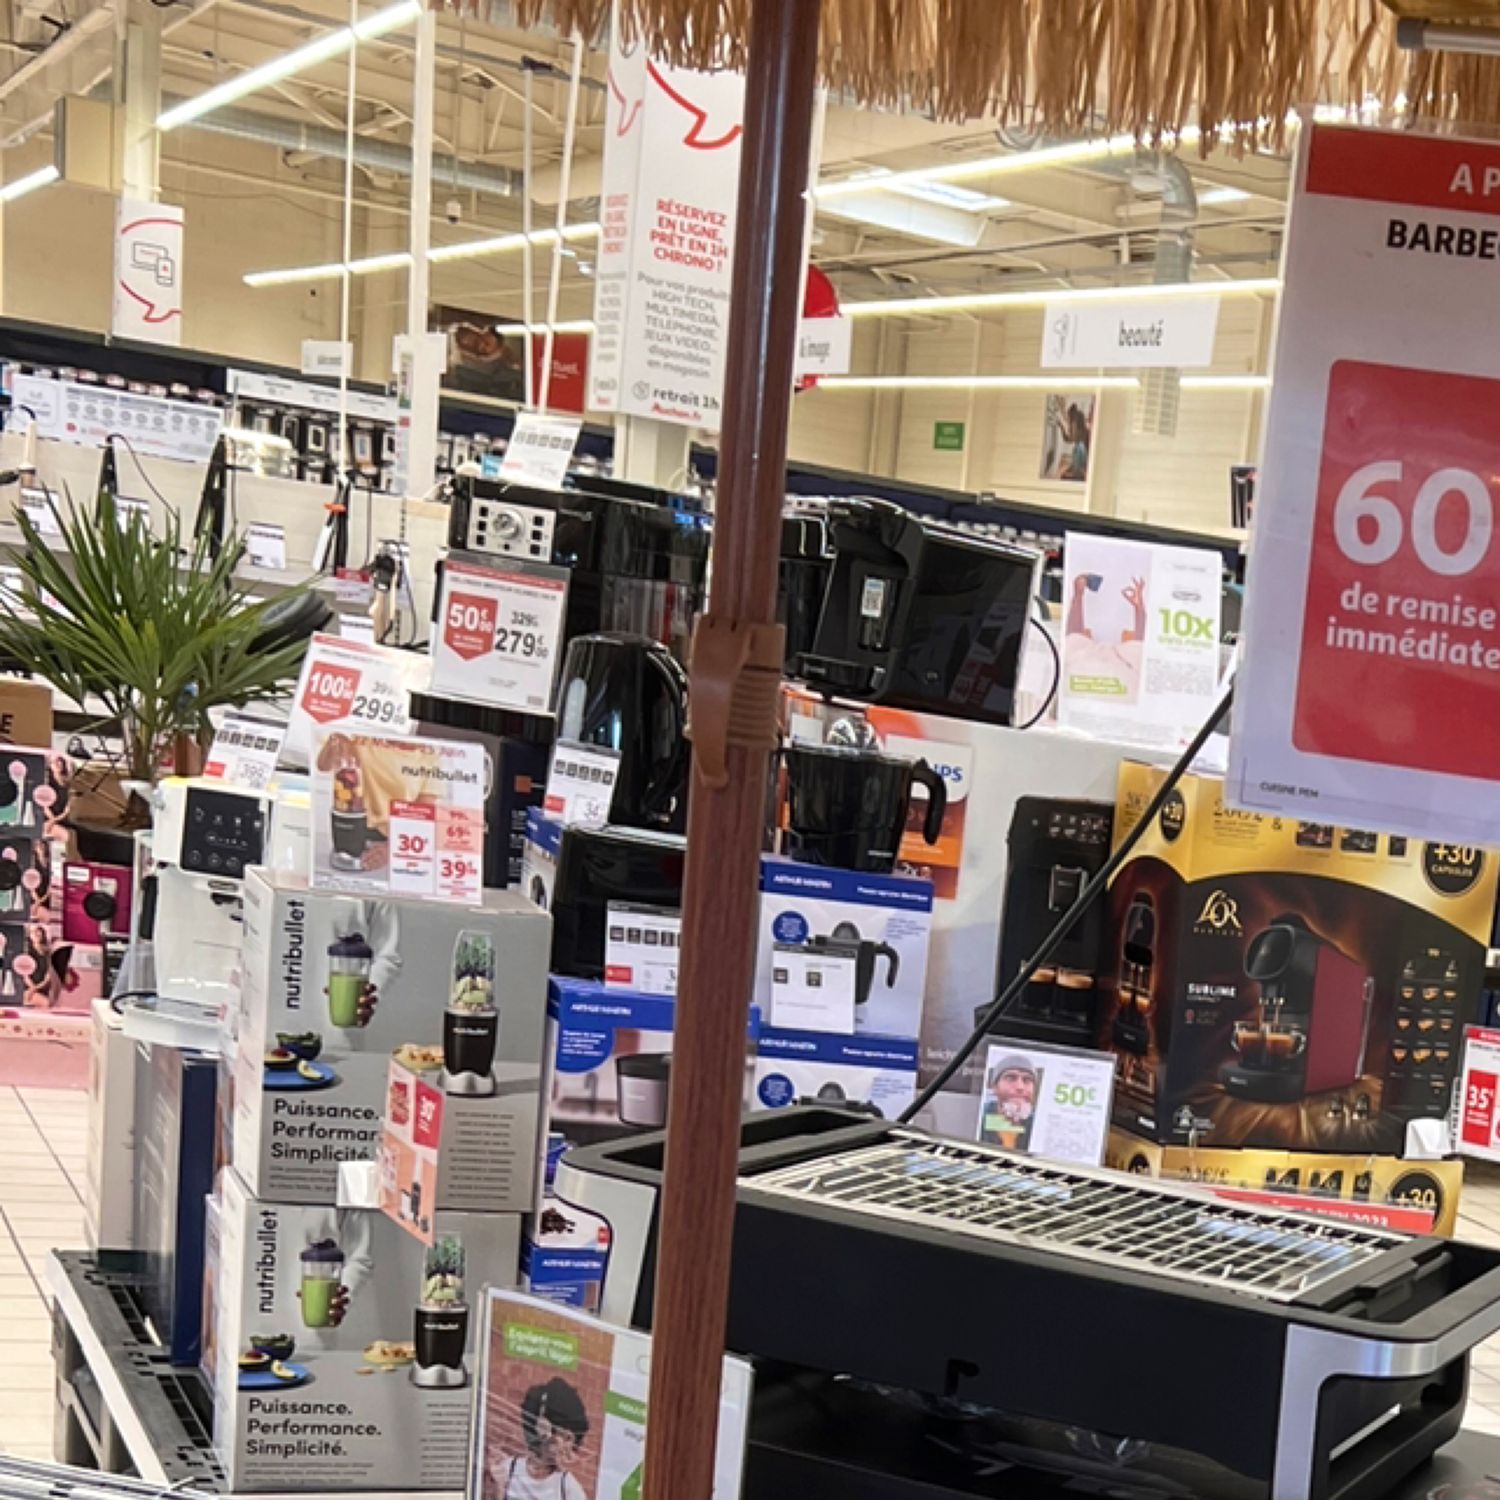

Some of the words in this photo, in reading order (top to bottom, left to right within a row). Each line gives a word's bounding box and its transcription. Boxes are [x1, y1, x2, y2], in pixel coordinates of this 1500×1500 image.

[1449, 162, 1475, 194] A
[658, 216, 675, 230] EN
[689, 238, 706, 252] EN
[654, 247, 713, 271] CHRONO
[1117, 320, 1163, 348] beauté
[653, 388, 699, 406] retrait
[1340, 581, 1380, 614] de
[1387, 592, 1497, 631] remise
[1158, 607, 1214, 639] 10x
[402, 763, 478, 785] nutribullet
[1434, 844, 1474, 866] +30
[1432, 863, 1473, 876] CAPSULES
[283, 901, 305, 1009] nutribullet
[1188, 983, 1236, 997] SUBLIME
[273, 1098, 380, 1121] Puissance.
[260, 1210, 278, 1313] nutribullet
[248, 1398, 352, 1418] Puissance.
[247, 1418, 381, 1440] Performance.
[246, 1440, 347, 1461] Simplicité.
